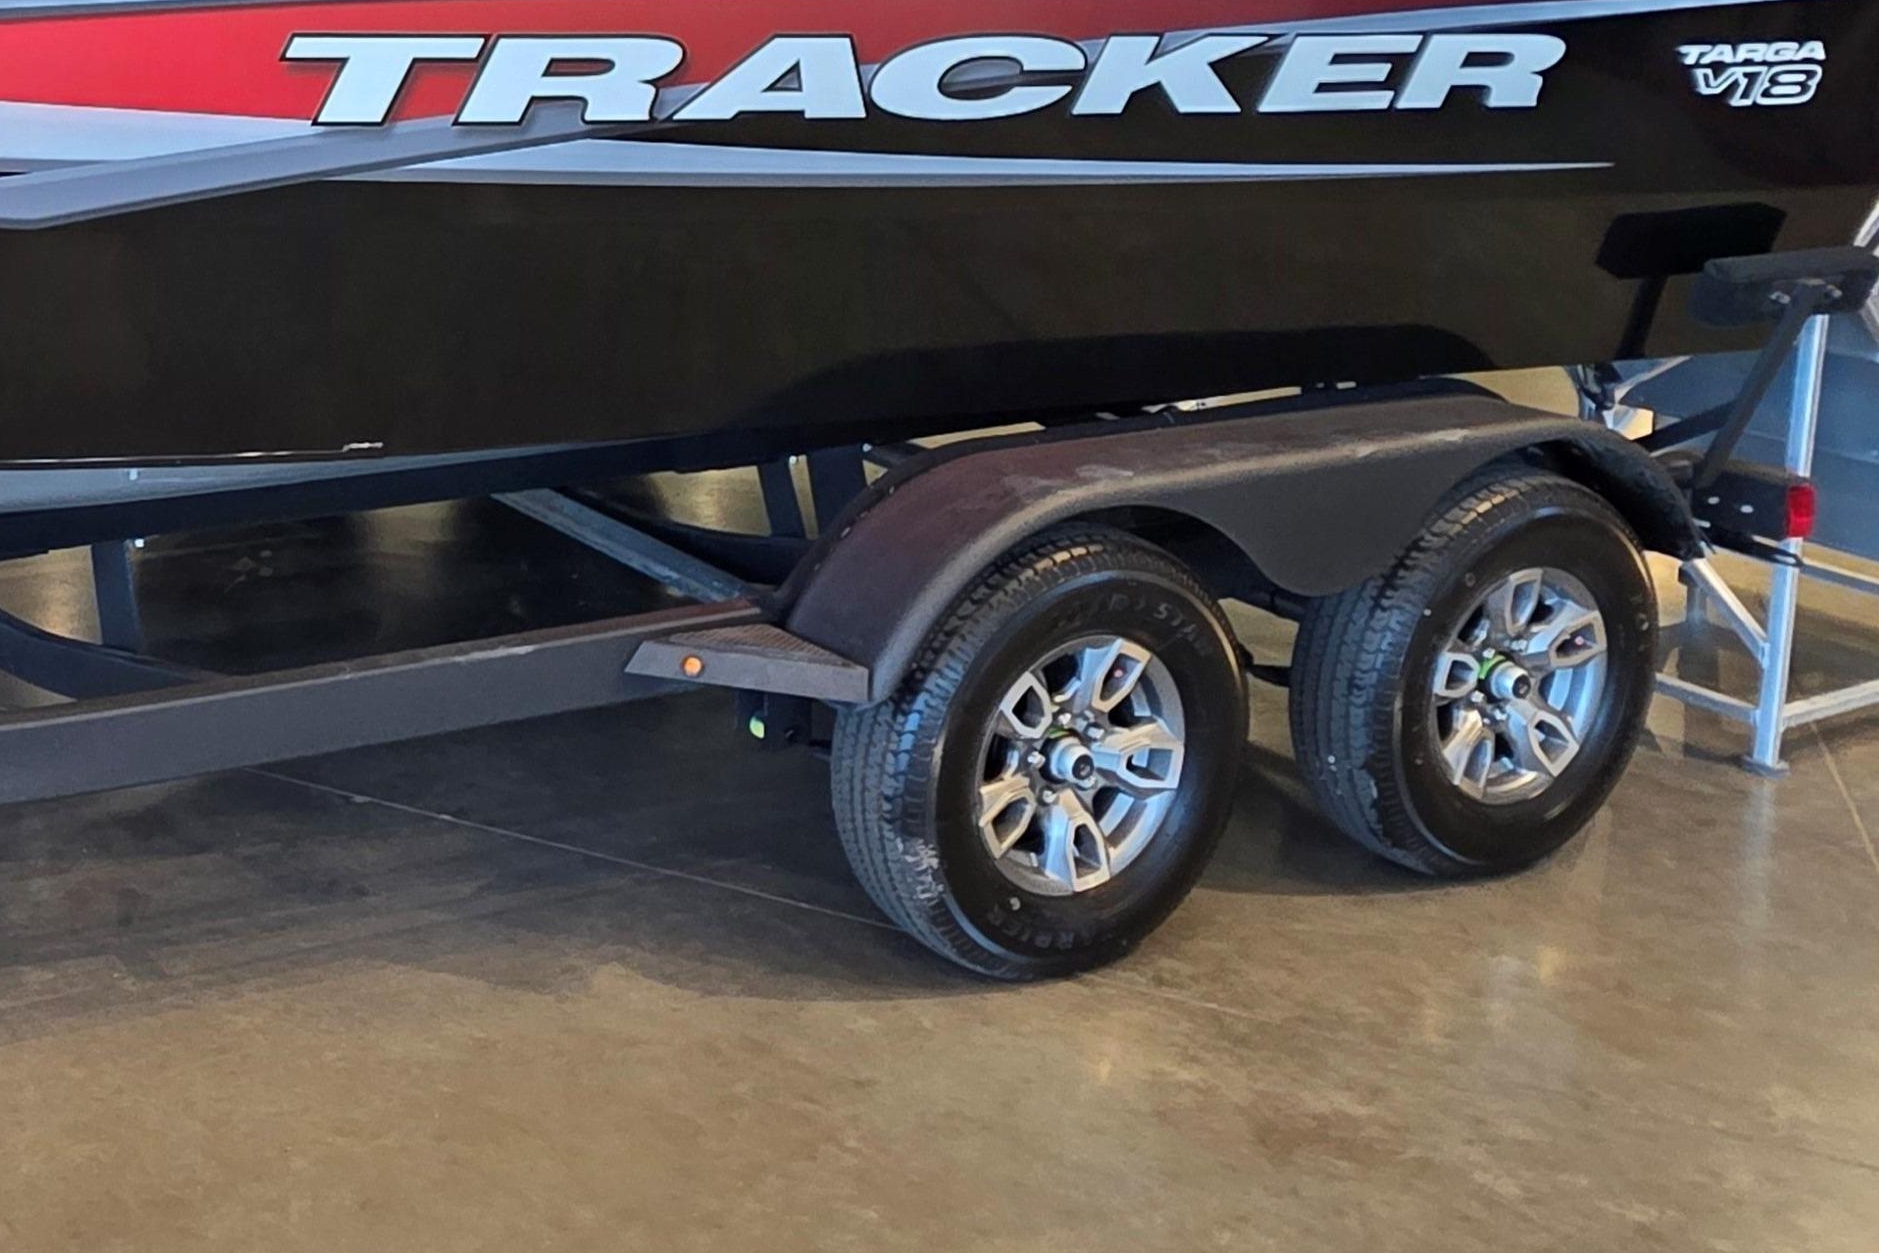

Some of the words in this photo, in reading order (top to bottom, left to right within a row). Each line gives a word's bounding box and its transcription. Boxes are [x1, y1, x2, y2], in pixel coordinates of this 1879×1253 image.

[1678, 40, 1827, 65] TARGA
[279, 30, 1568, 126] TRACKER
[1695, 64, 1824, 108] V18
